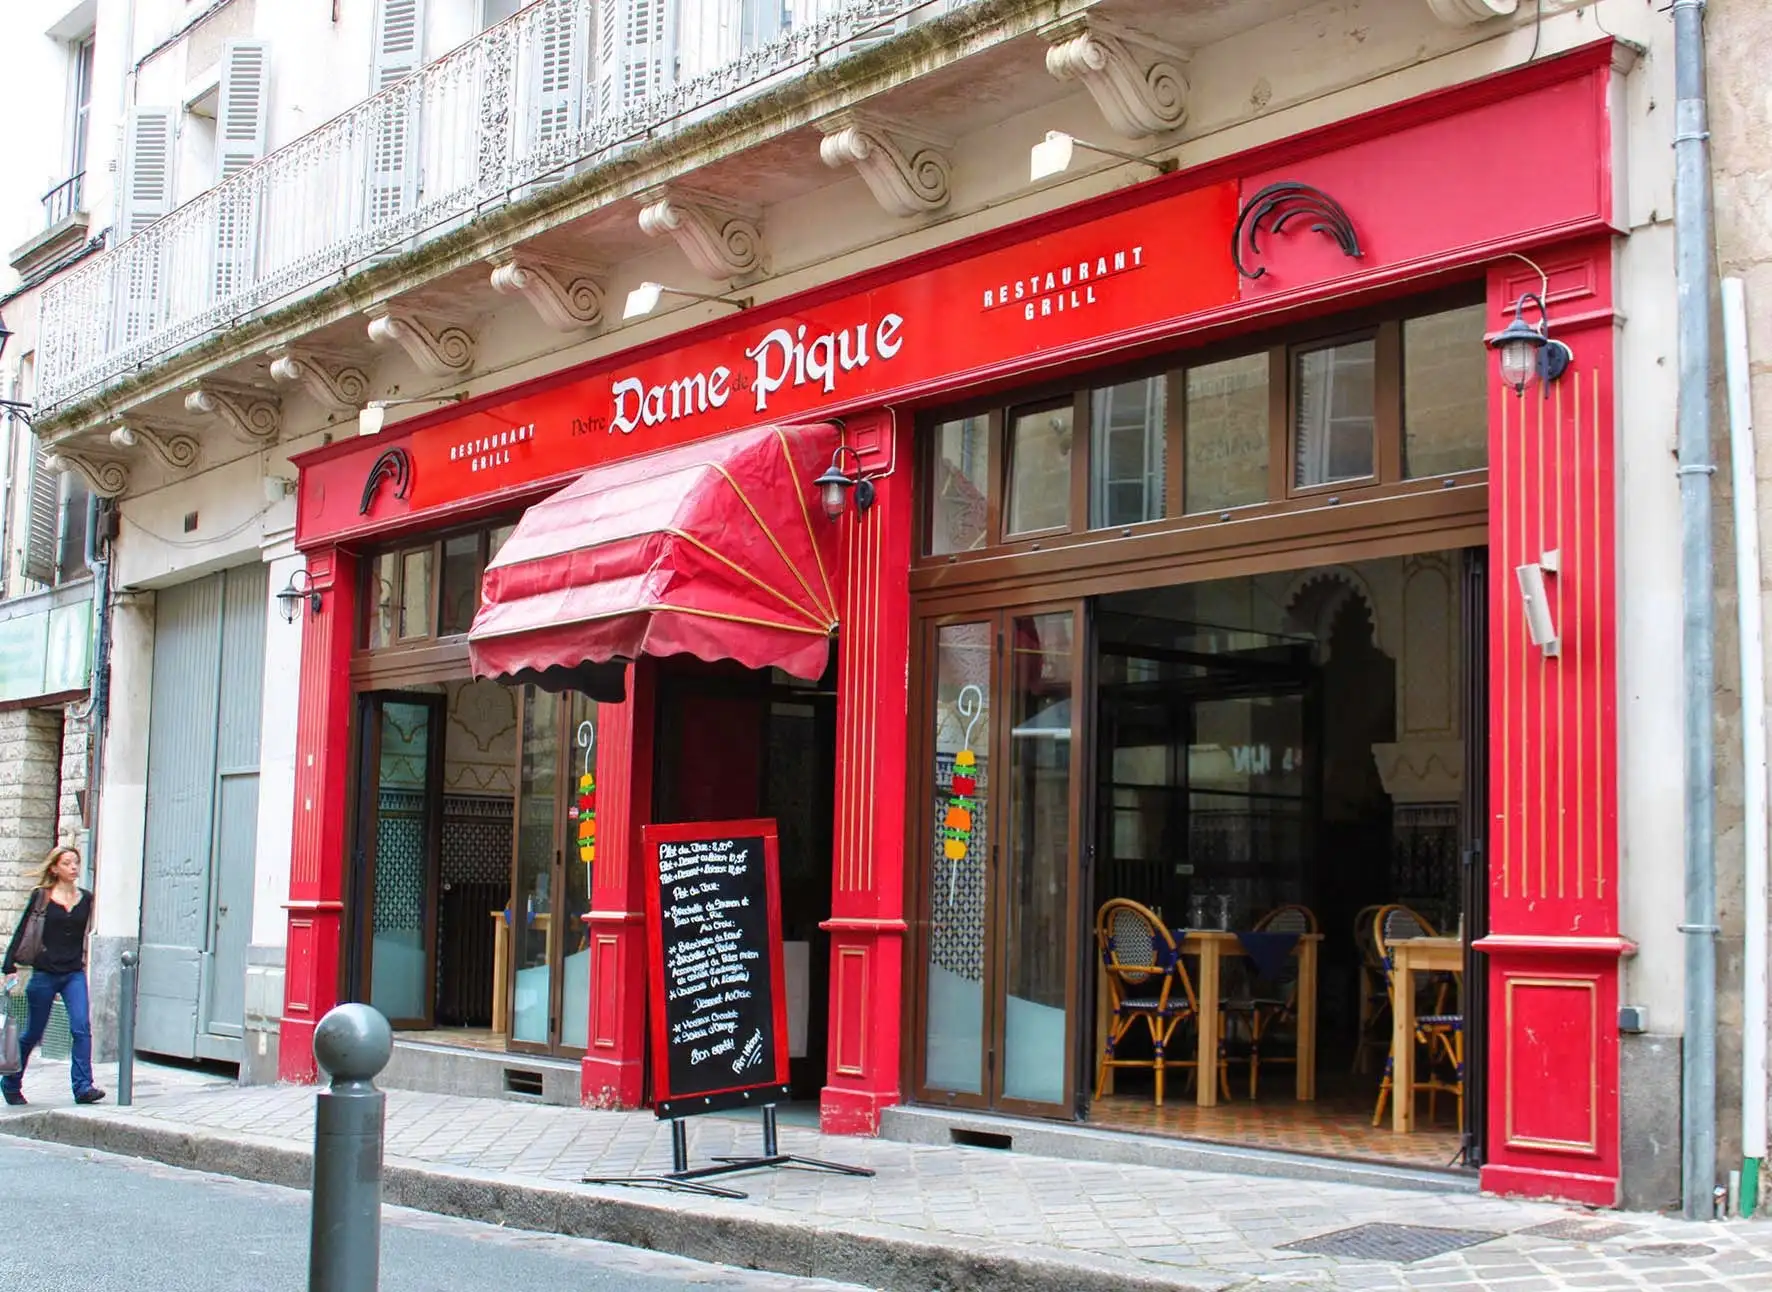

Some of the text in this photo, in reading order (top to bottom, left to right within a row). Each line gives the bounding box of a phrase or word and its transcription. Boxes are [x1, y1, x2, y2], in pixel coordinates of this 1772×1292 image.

[983, 247, 1142, 307] RESTAURANT
[1025, 286, 1096, 320] GRILL
[608, 366, 731, 434] Dame
[745, 313, 903, 412] Pique
[450, 423, 534, 460] RESTAURANT
[471, 449, 510, 472] GRILL
[659, 843, 677, 860] Plat
[691, 1048, 710, 1065] Bon
